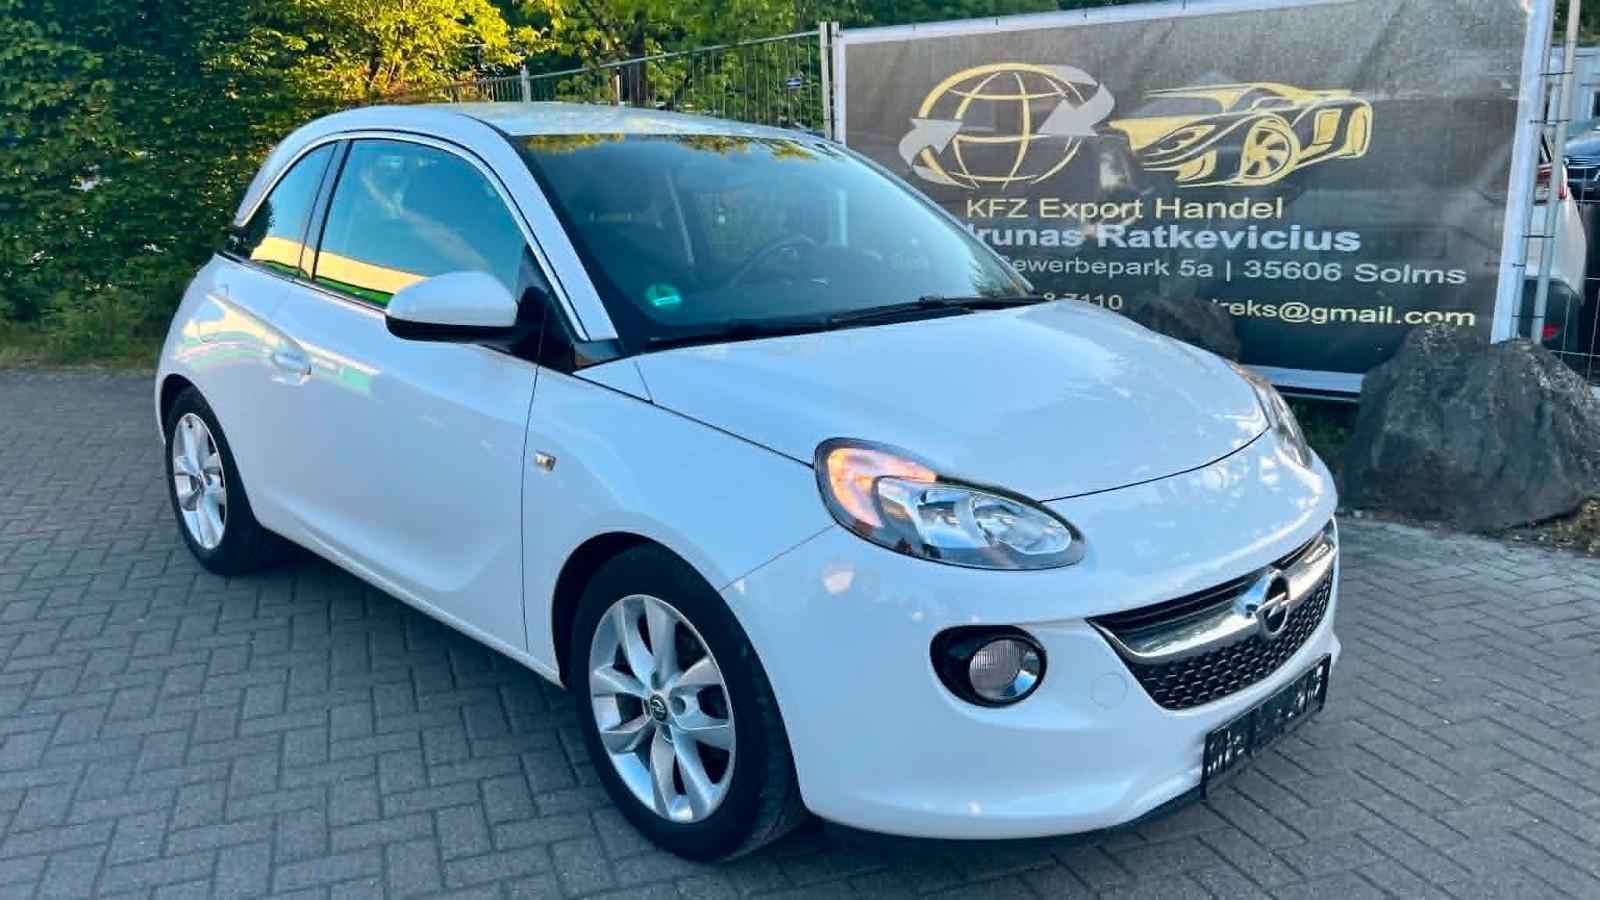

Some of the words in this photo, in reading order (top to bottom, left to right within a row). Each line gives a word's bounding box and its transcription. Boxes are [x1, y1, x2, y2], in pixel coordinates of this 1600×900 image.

[966, 198, 1027, 218] KFZ
[1039, 198, 1143, 222] Export
[1156, 197, 1283, 220] Handel
[966, 224, 1085, 247] runas
[1097, 224, 1361, 251] Ratkevicius
[1001, 256, 1170, 278] ewerbepark
[1179, 259, 1213, 278] 5a
[1244, 261, 1342, 282] 35606
[1354, 263, 1467, 284] Solms
[1212, 298, 1476, 326] eks@gmail.com
